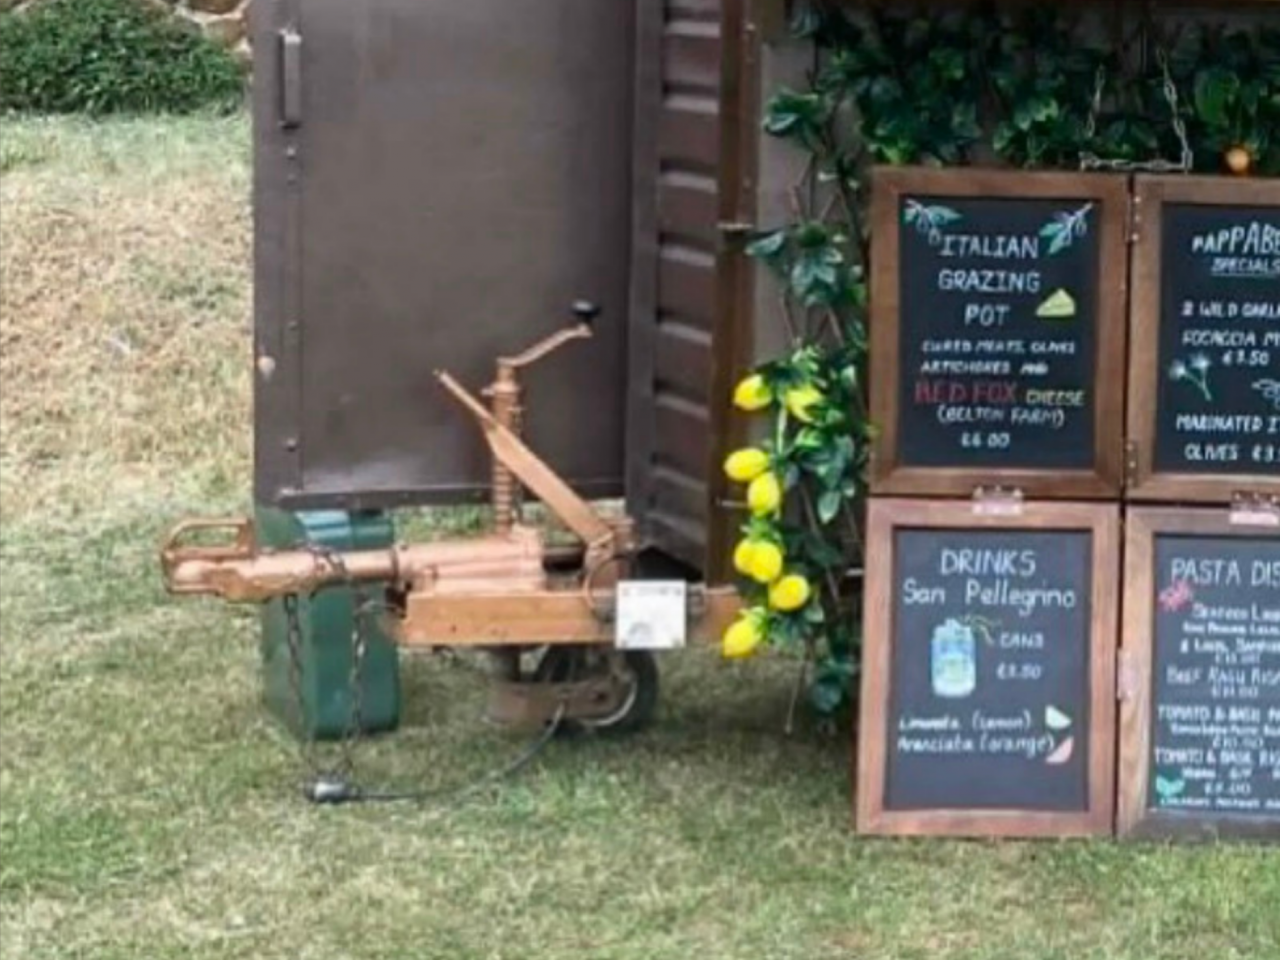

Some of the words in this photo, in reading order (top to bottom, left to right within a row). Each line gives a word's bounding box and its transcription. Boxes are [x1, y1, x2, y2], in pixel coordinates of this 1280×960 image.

[939, 234, 1039, 259] ITALIAN
[938, 270, 1040, 293] GRAZING
[964, 304, 1011, 326] POT
[1199, 301, 1238, 318] WILD
[913, 381, 966, 404] RED
[972, 381, 1018, 404] FOX
[1176, 414, 1263, 433] MARINATED
[1184, 442, 1239, 461] OLIVES
[940, 548, 1036, 577] DRINKS
[1171, 558, 1241, 585] PASTA
[903, 578, 945, 606] San
[965, 578, 1077, 617] Pellegrino
